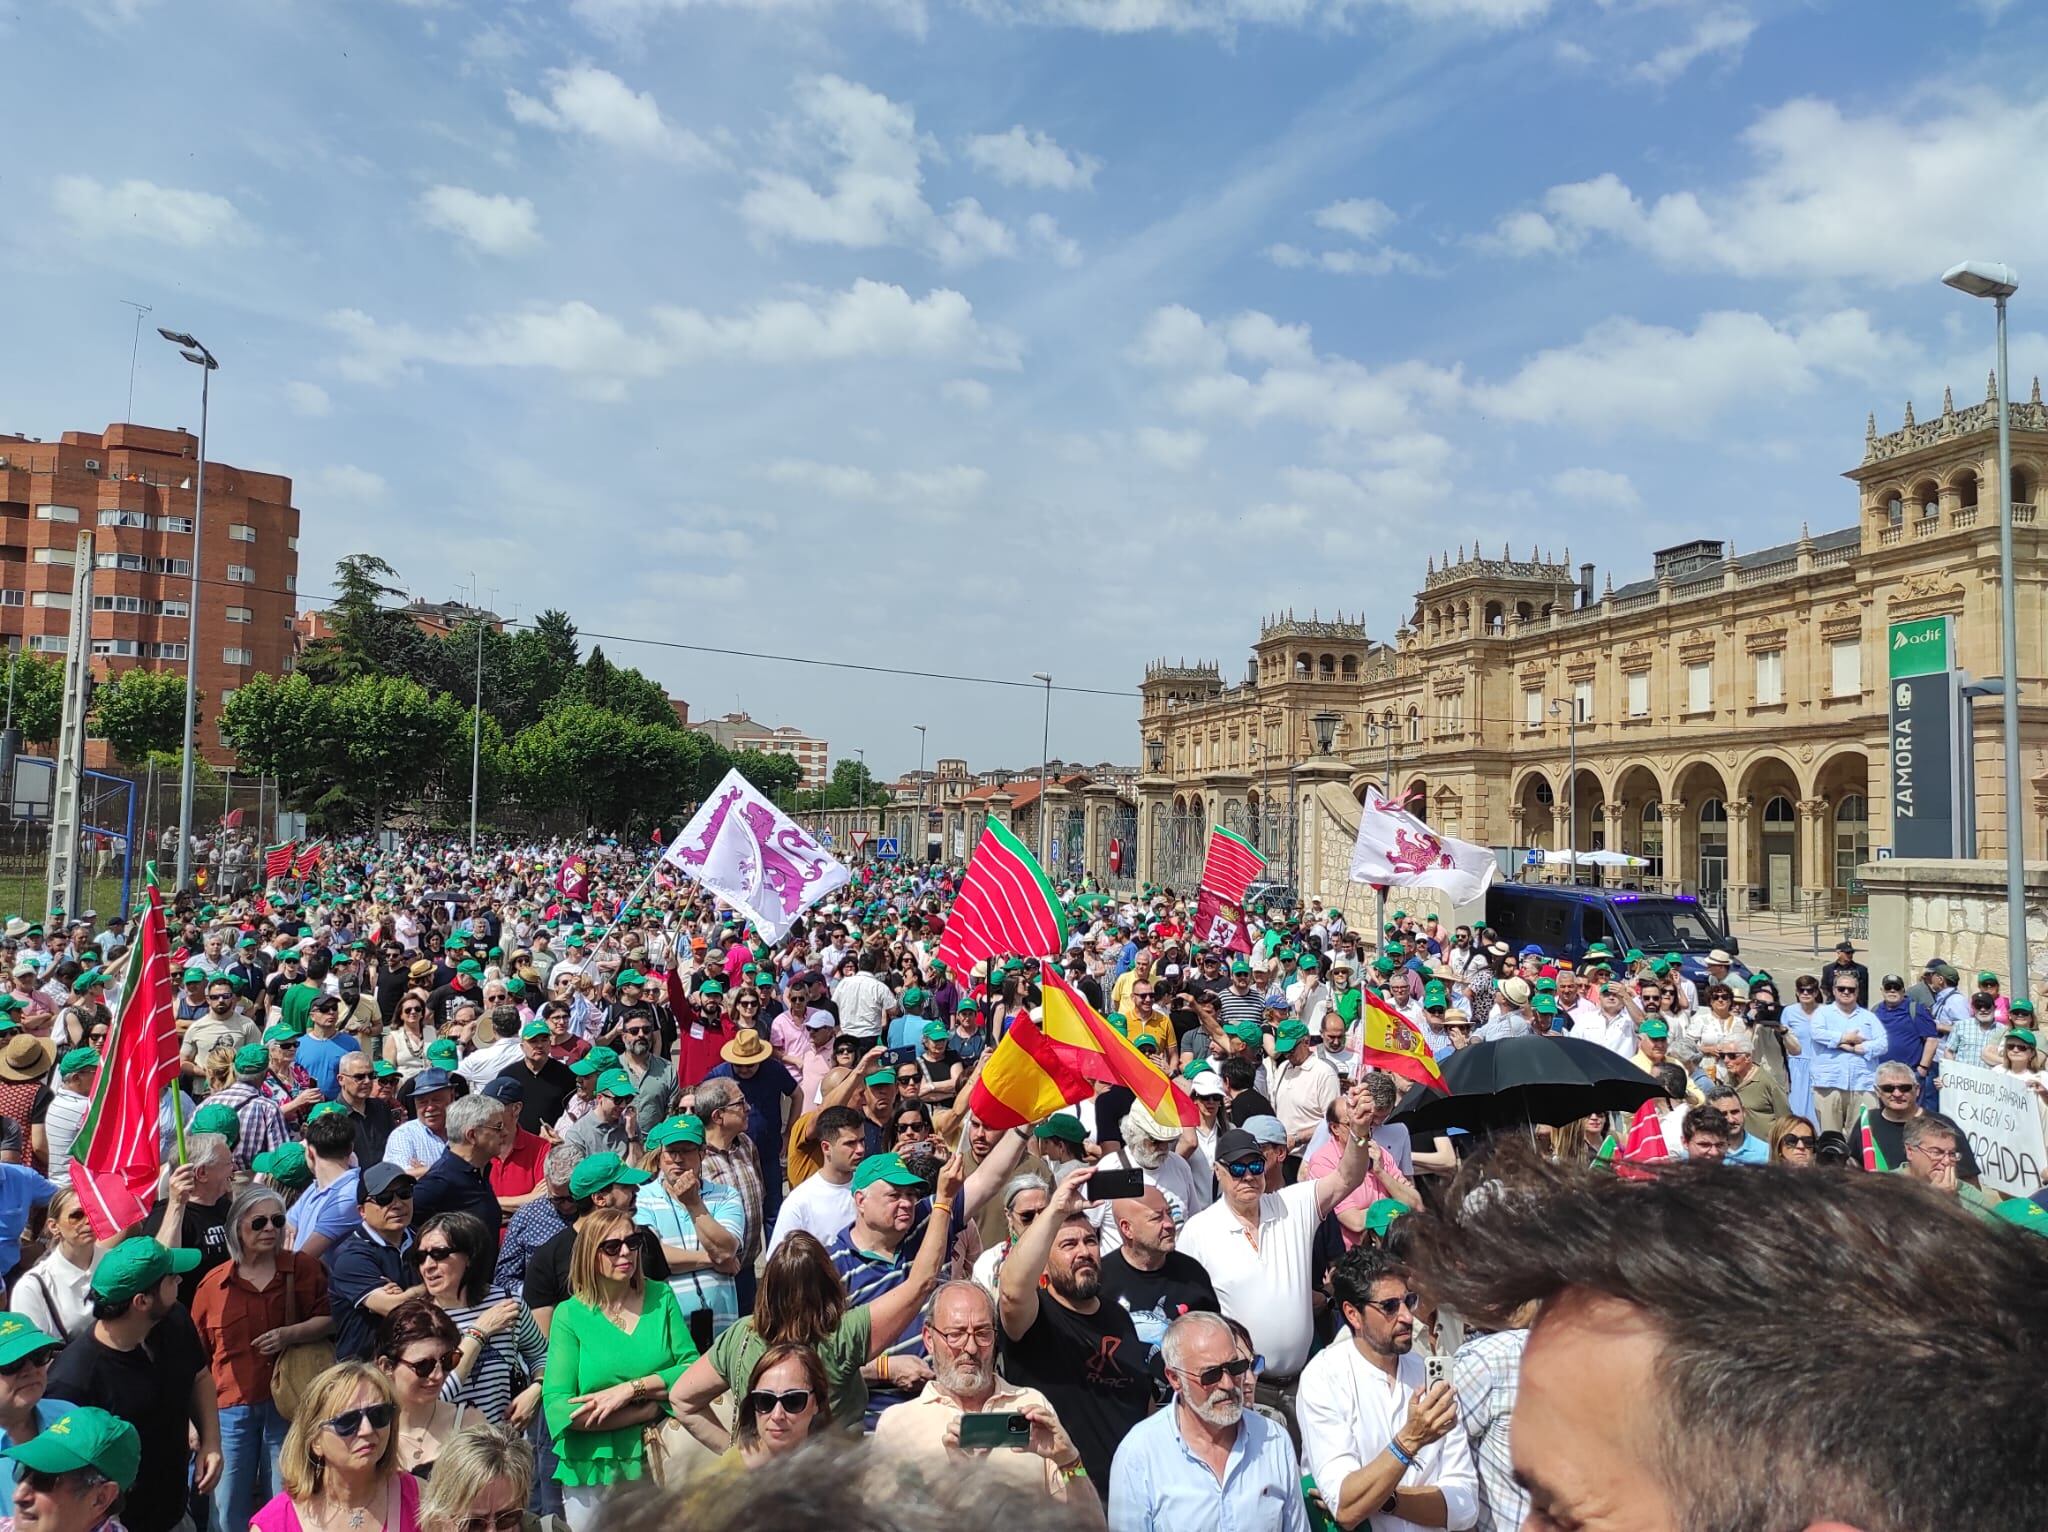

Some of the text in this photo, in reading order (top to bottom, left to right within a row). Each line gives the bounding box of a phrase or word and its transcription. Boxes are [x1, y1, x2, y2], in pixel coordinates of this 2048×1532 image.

[1910, 628, 1942, 643] adif
[1895, 719, 1913, 817] ZAMORA
[1958, 1101, 2002, 1128] EXIGEN
[1968, 1132, 2042, 1188] ARADA
